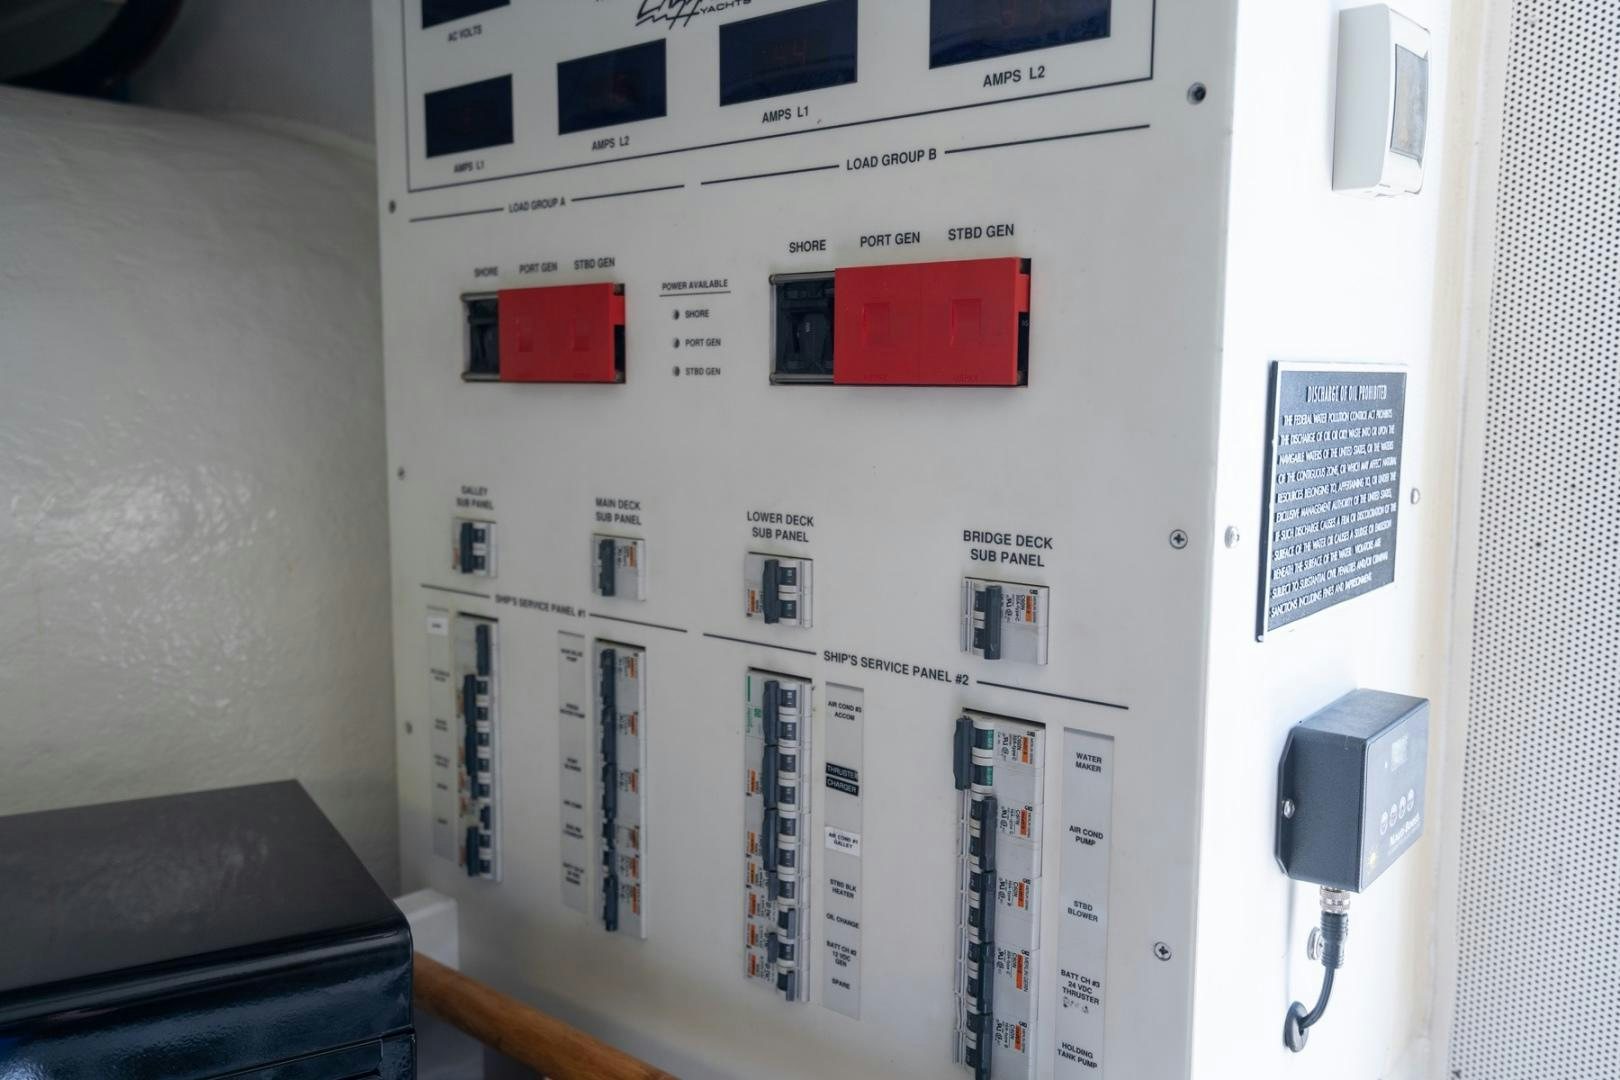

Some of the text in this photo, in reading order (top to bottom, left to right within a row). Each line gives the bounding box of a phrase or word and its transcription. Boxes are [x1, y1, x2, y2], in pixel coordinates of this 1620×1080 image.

[983, 66, 1045, 88] AMPS L2
[762, 106, 809, 124] AMPS L1
[592, 136, 630, 151] AMPS L2
[846, 149, 937, 170] LOAD GROUP B
[454, 162, 473, 173] AMPS
[508, 198, 566, 214] LOAD GROUP A
[948, 224, 1014, 240] STBD GEN
[789, 240, 826, 253] SHORE
[860, 232, 920, 248] PORT GEN
[519, 262, 558, 274] PORT GEN
[574, 257, 615, 270] STBD GEN
[474, 267, 498, 278] SHORE
[662, 278, 728, 291] POWER AVAILABLE
[685, 309, 710, 318] SHORE
[685, 338, 722, 347] PORT GEN
[685, 367, 721, 376] STBD GEN
[1307, 386, 1338, 402] DISCHARGE
[461, 485, 488, 496] GALLEY
[456, 497, 494, 510] SUB PANEL
[595, 497, 640, 511] MAIN DECK
[595, 512, 642, 526] SUB PANEL
[747, 511, 814, 528] LOWER DECK
[752, 527, 809, 543] SUB PANEL
[963, 530, 1054, 550] BRIDGE DECK
[970, 548, 1044, 568] SUB PANEL
[518, 597, 550, 612] SERVICE
[551, 602, 576, 618] PANEL
[823, 650, 970, 686] SHIP'S SERVICE PANEL #2
[838, 702, 854, 712] COND
[834, 712, 855, 720] ACCOM
[1076, 752, 1102, 764] WATER
[1075, 761, 1102, 774] MAKER
[827, 778, 857, 794] CHARGER
[1069, 825, 1104, 840] AIR COND
[834, 840, 854, 849] GALLEY
[1076, 836, 1096, 846] PUMP
[830, 879, 857, 892] STBD BLK
[832, 888, 855, 899] HEATER
[1074, 900, 1092, 912] STBD
[1068, 907, 1098, 922] BLOWER
[836, 916, 860, 929] CHANGE
[1061, 969, 1079, 980] BATT
[1080, 976, 1090, 985] CH
[1068, 980, 1092, 994] 24 VDC
[1062, 986, 1100, 1006] THRUSTER
[1062, 1042, 1093, 1060] HOLDING
[1057, 1049, 1098, 1070] TANK PUMP
